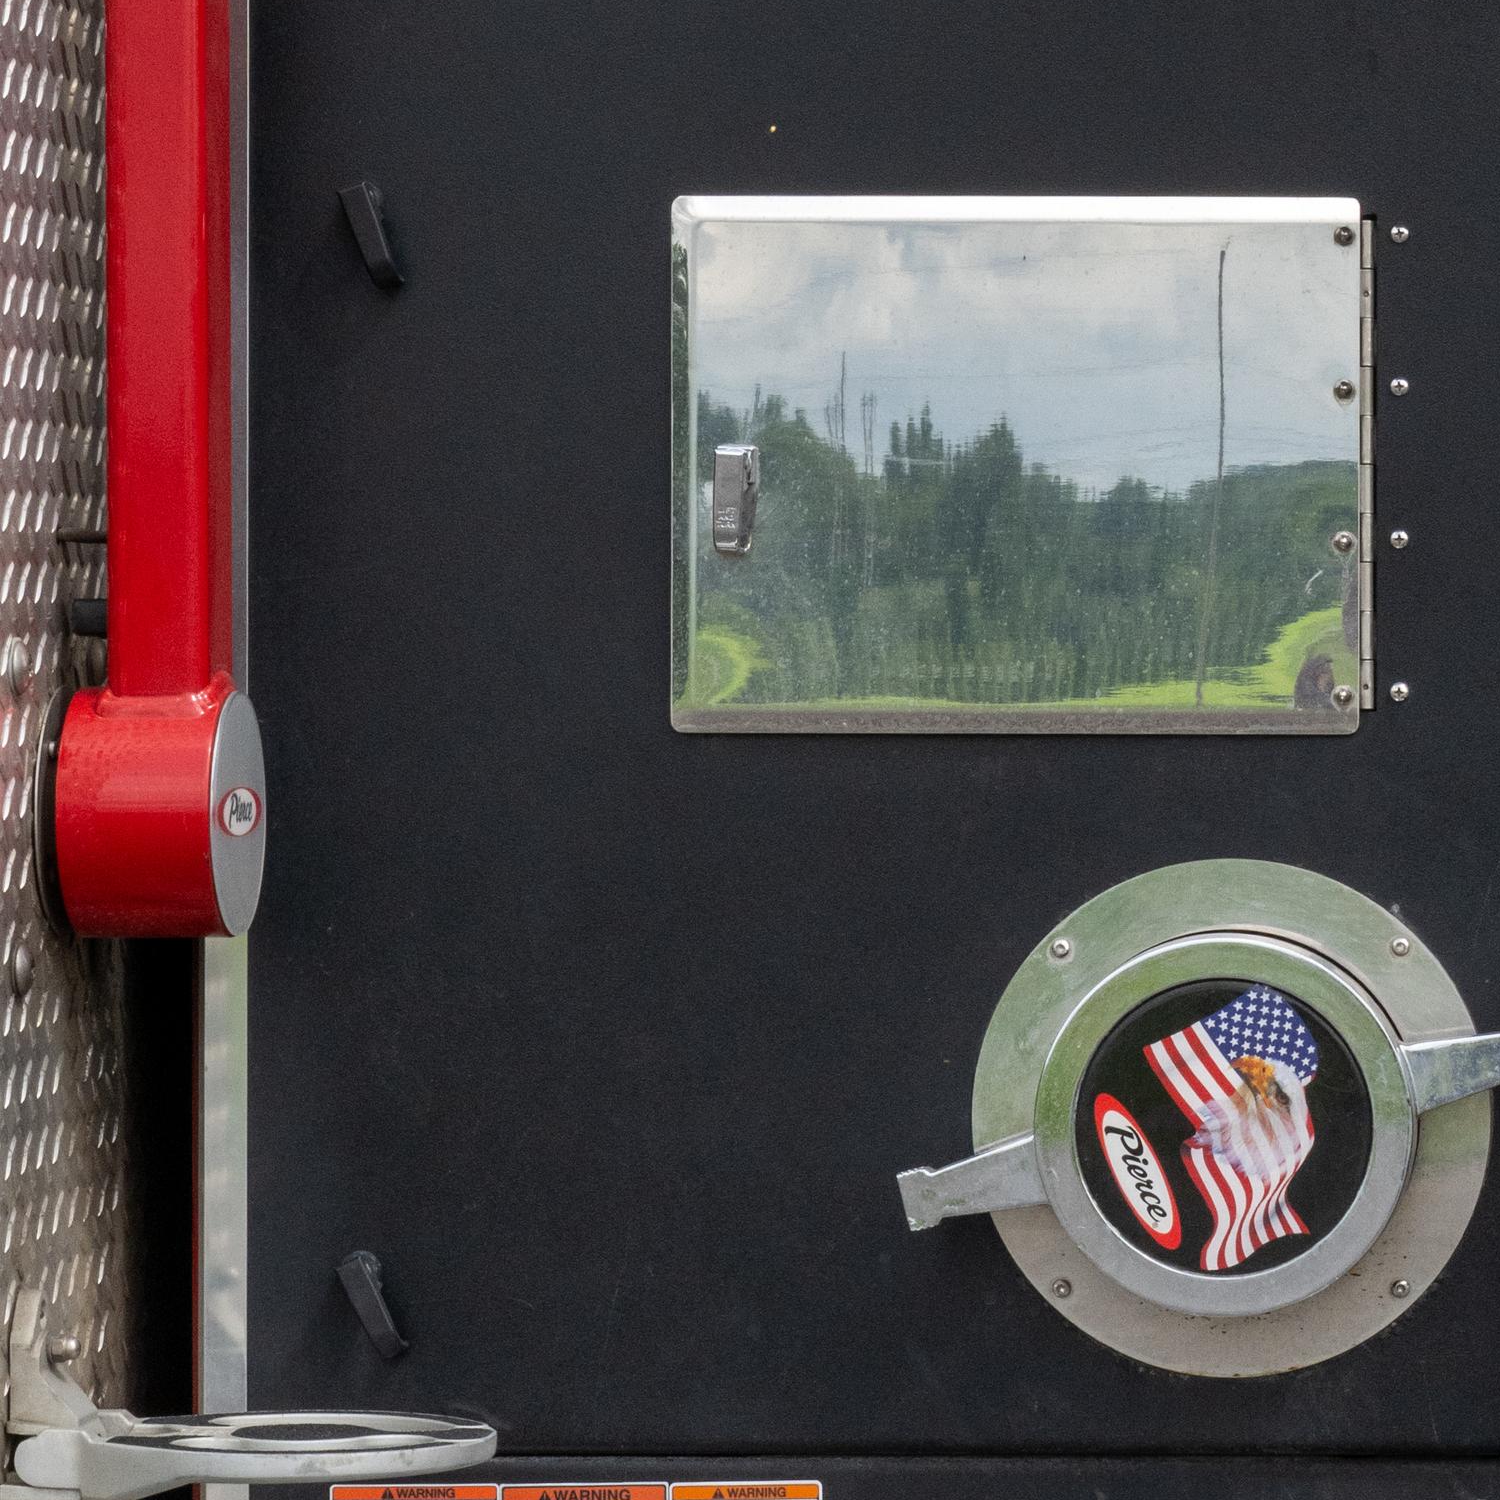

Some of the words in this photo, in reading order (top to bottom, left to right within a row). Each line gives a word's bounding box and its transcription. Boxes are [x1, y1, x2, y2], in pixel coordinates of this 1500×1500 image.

[229, 793, 252, 829] Pierce
[1104, 1125, 1167, 1223] Pierce
[397, 1488, 455, 1499] WARNING
[727, 1487, 786, 1498] WARNING
